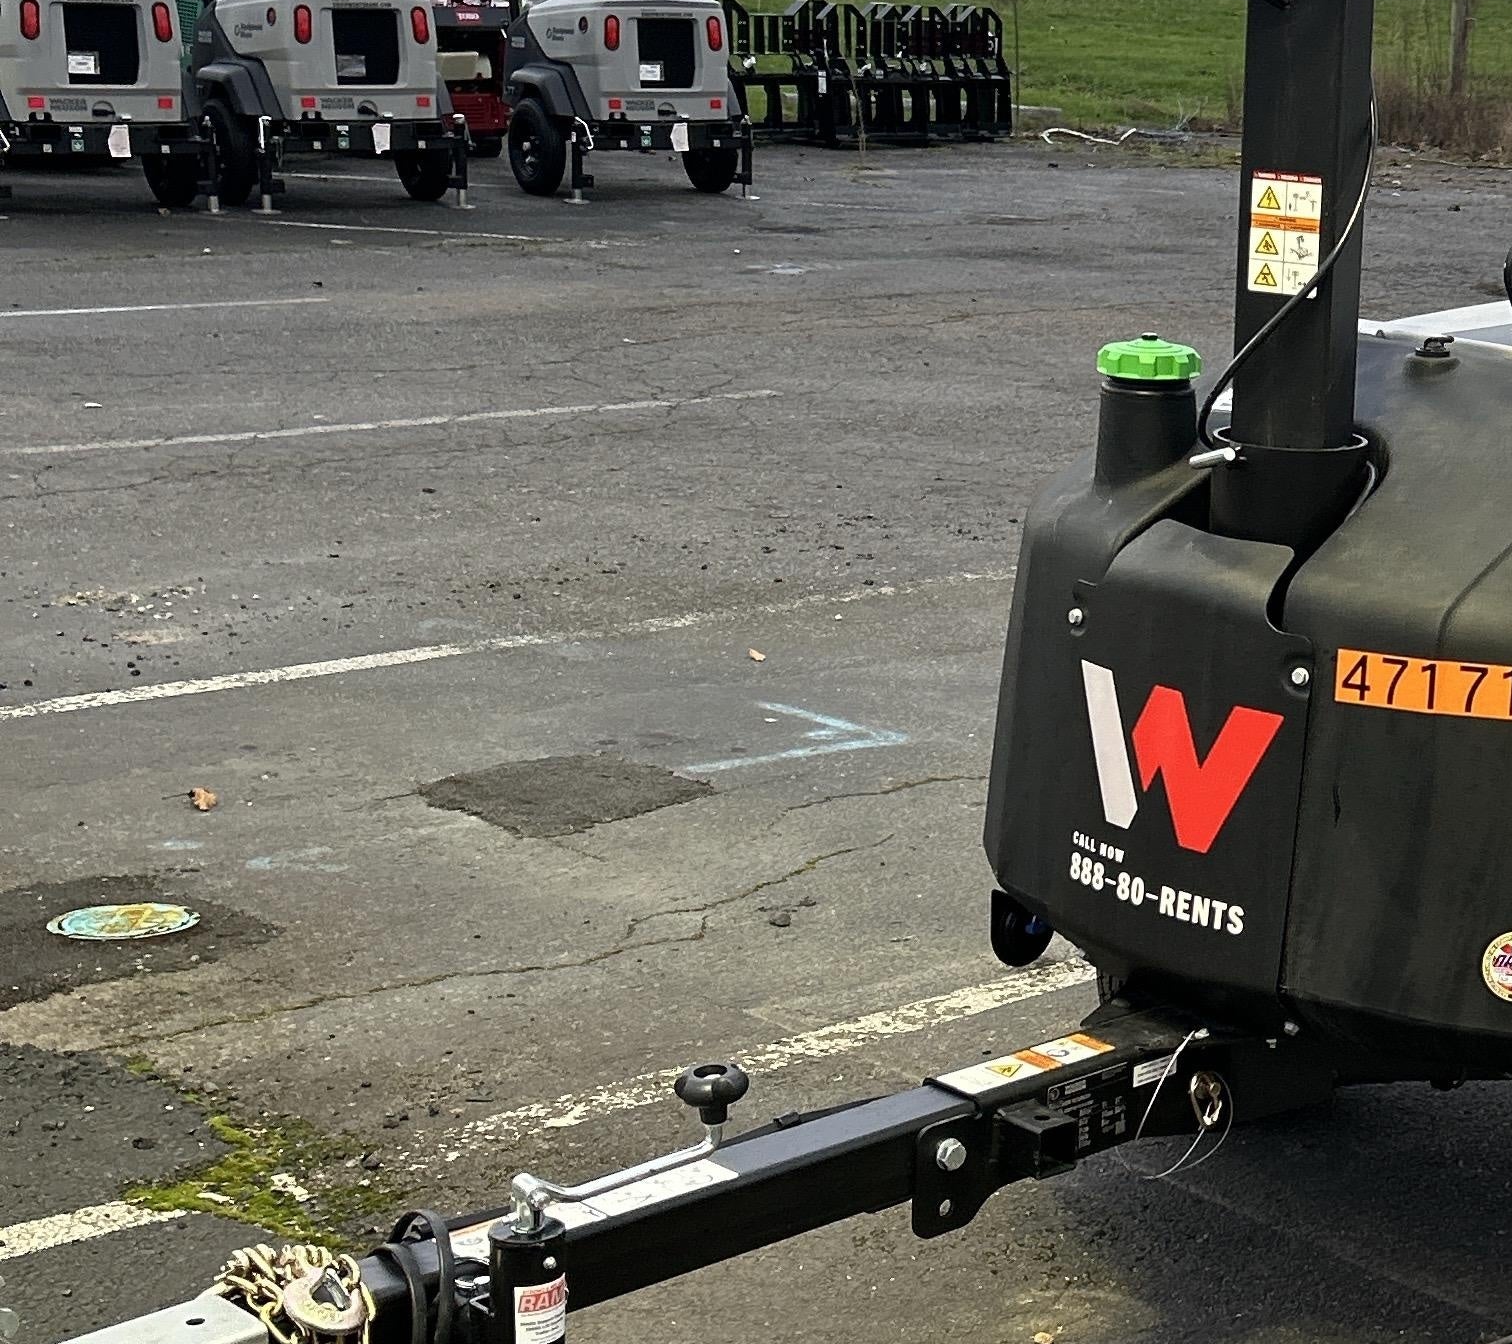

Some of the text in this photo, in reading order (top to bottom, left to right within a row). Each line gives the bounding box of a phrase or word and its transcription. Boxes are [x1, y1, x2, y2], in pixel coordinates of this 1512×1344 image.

[1072, 830, 1097, 853] CALL
[1099, 842, 1125, 864] NOW
[1069, 851, 1245, 936] 888-80-RENTS
